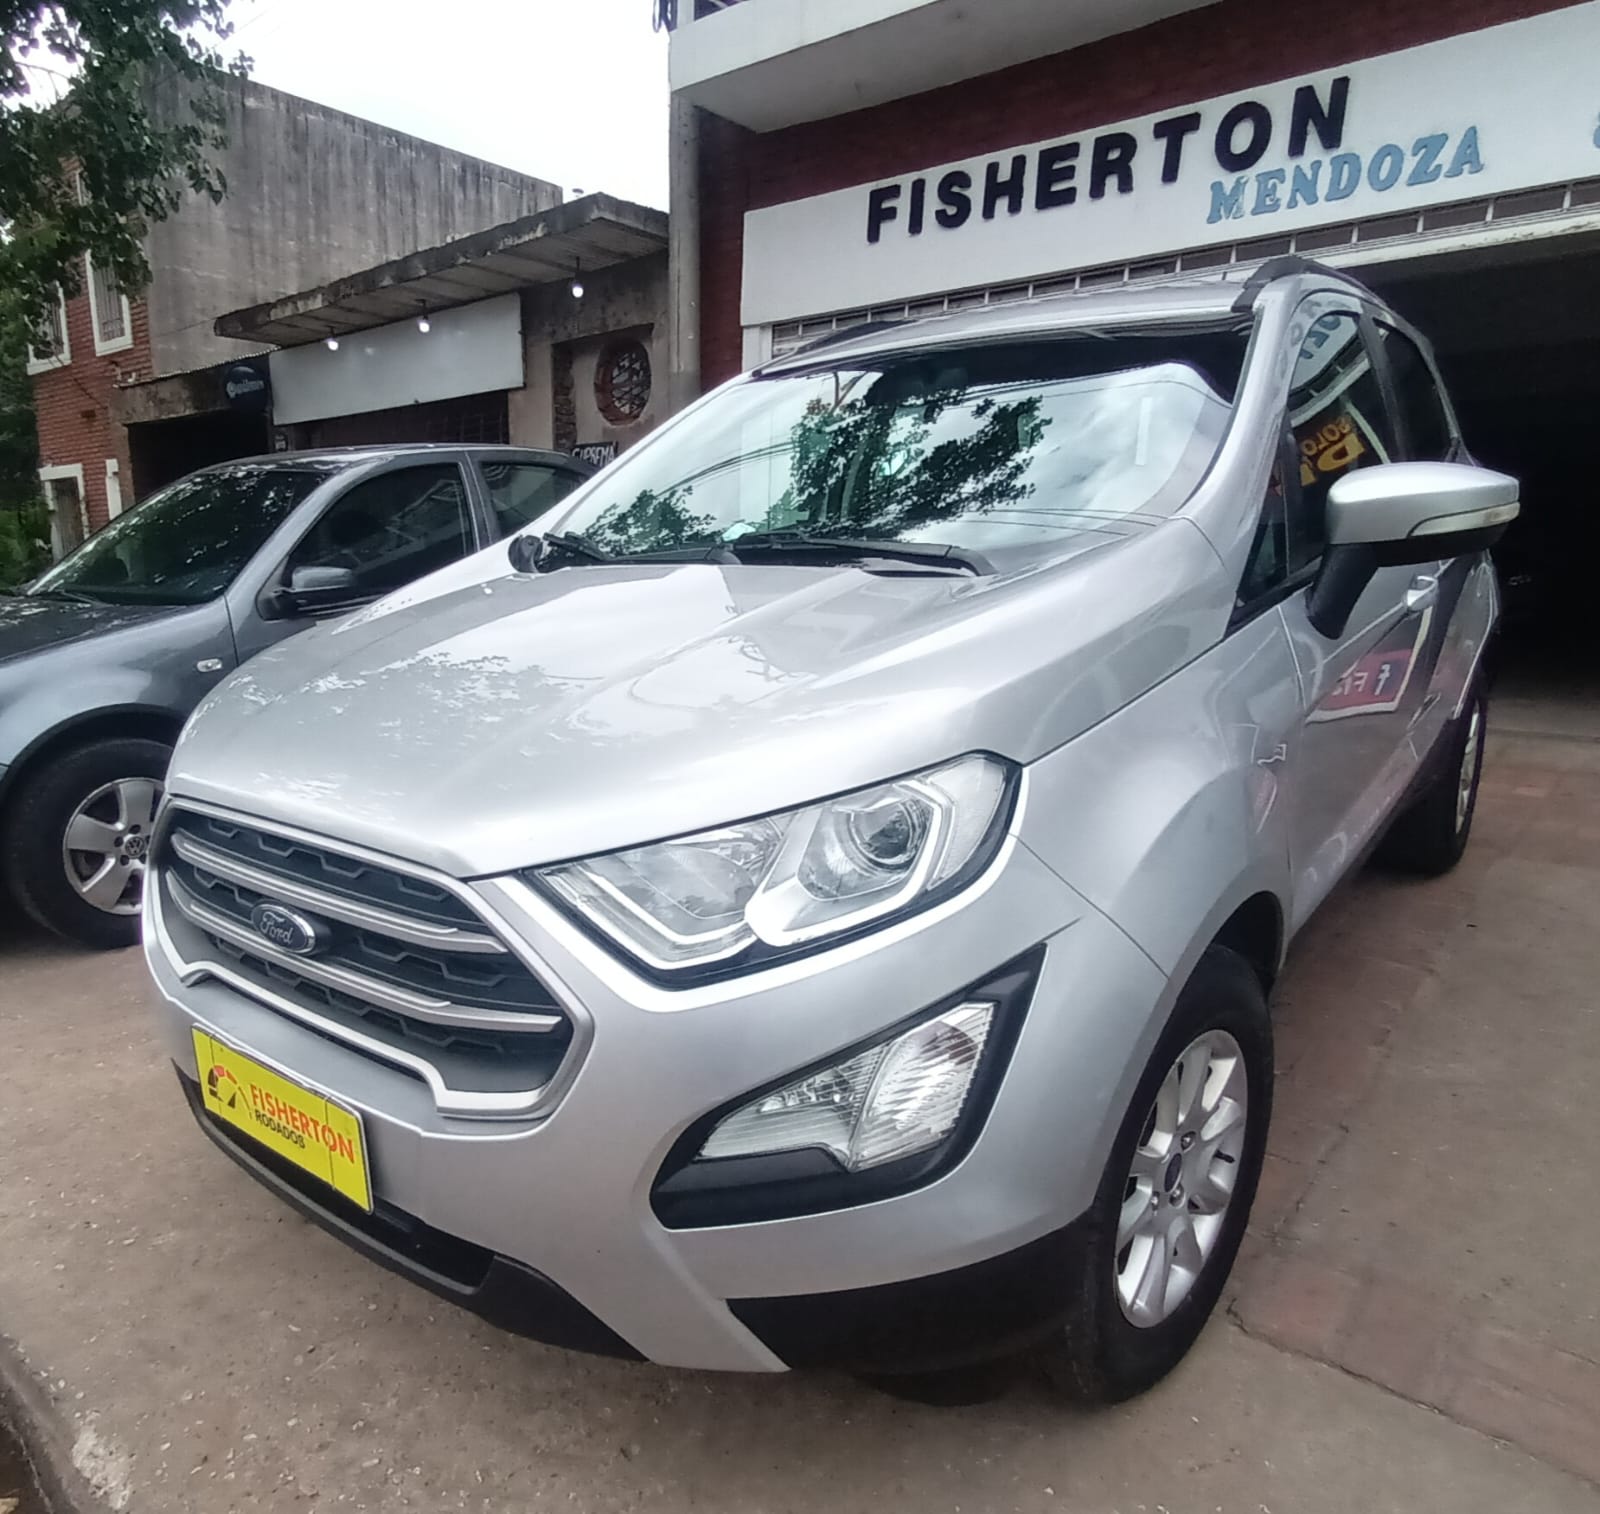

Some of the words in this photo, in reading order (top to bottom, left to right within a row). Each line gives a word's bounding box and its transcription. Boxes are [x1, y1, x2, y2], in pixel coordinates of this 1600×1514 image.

[867, 74, 1350, 243] FISHERTON
[1206, 125, 1485, 224] MENDOZA
[260, 911, 295, 945] Ford
[250, 1083, 355, 1165] FISHERTON
[254, 1109, 306, 1150] RODADOS
